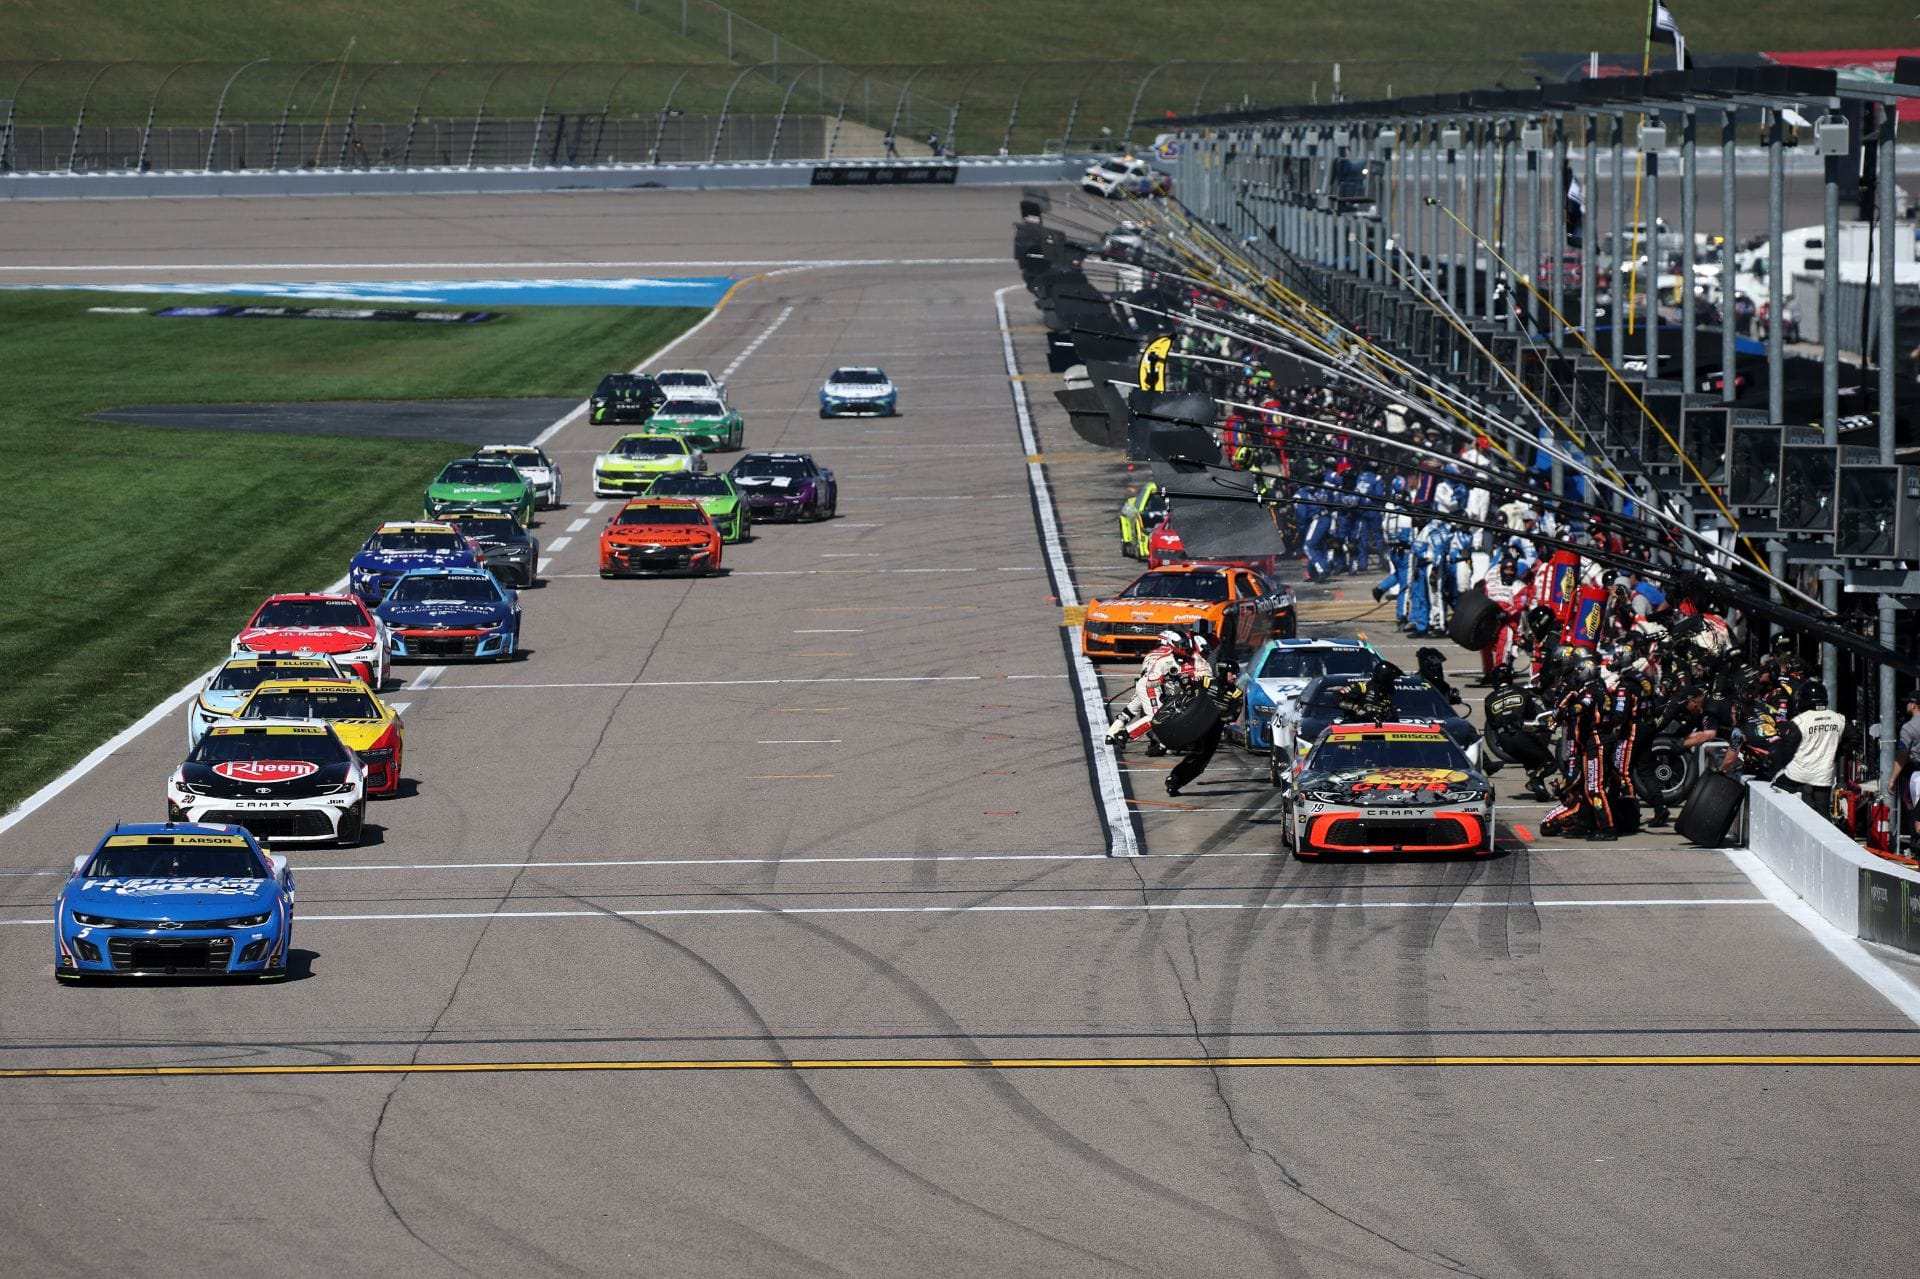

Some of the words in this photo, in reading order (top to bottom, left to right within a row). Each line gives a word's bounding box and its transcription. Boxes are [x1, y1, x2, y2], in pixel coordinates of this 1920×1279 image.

[1588, 603, 1601, 639] SUNOCO
[227, 760, 314, 776] Rheem
[1350, 782, 1448, 793] CLUB
[181, 795, 196, 804] 20
[1310, 802, 1325, 813] 19
[77, 927, 92, 938] 5
